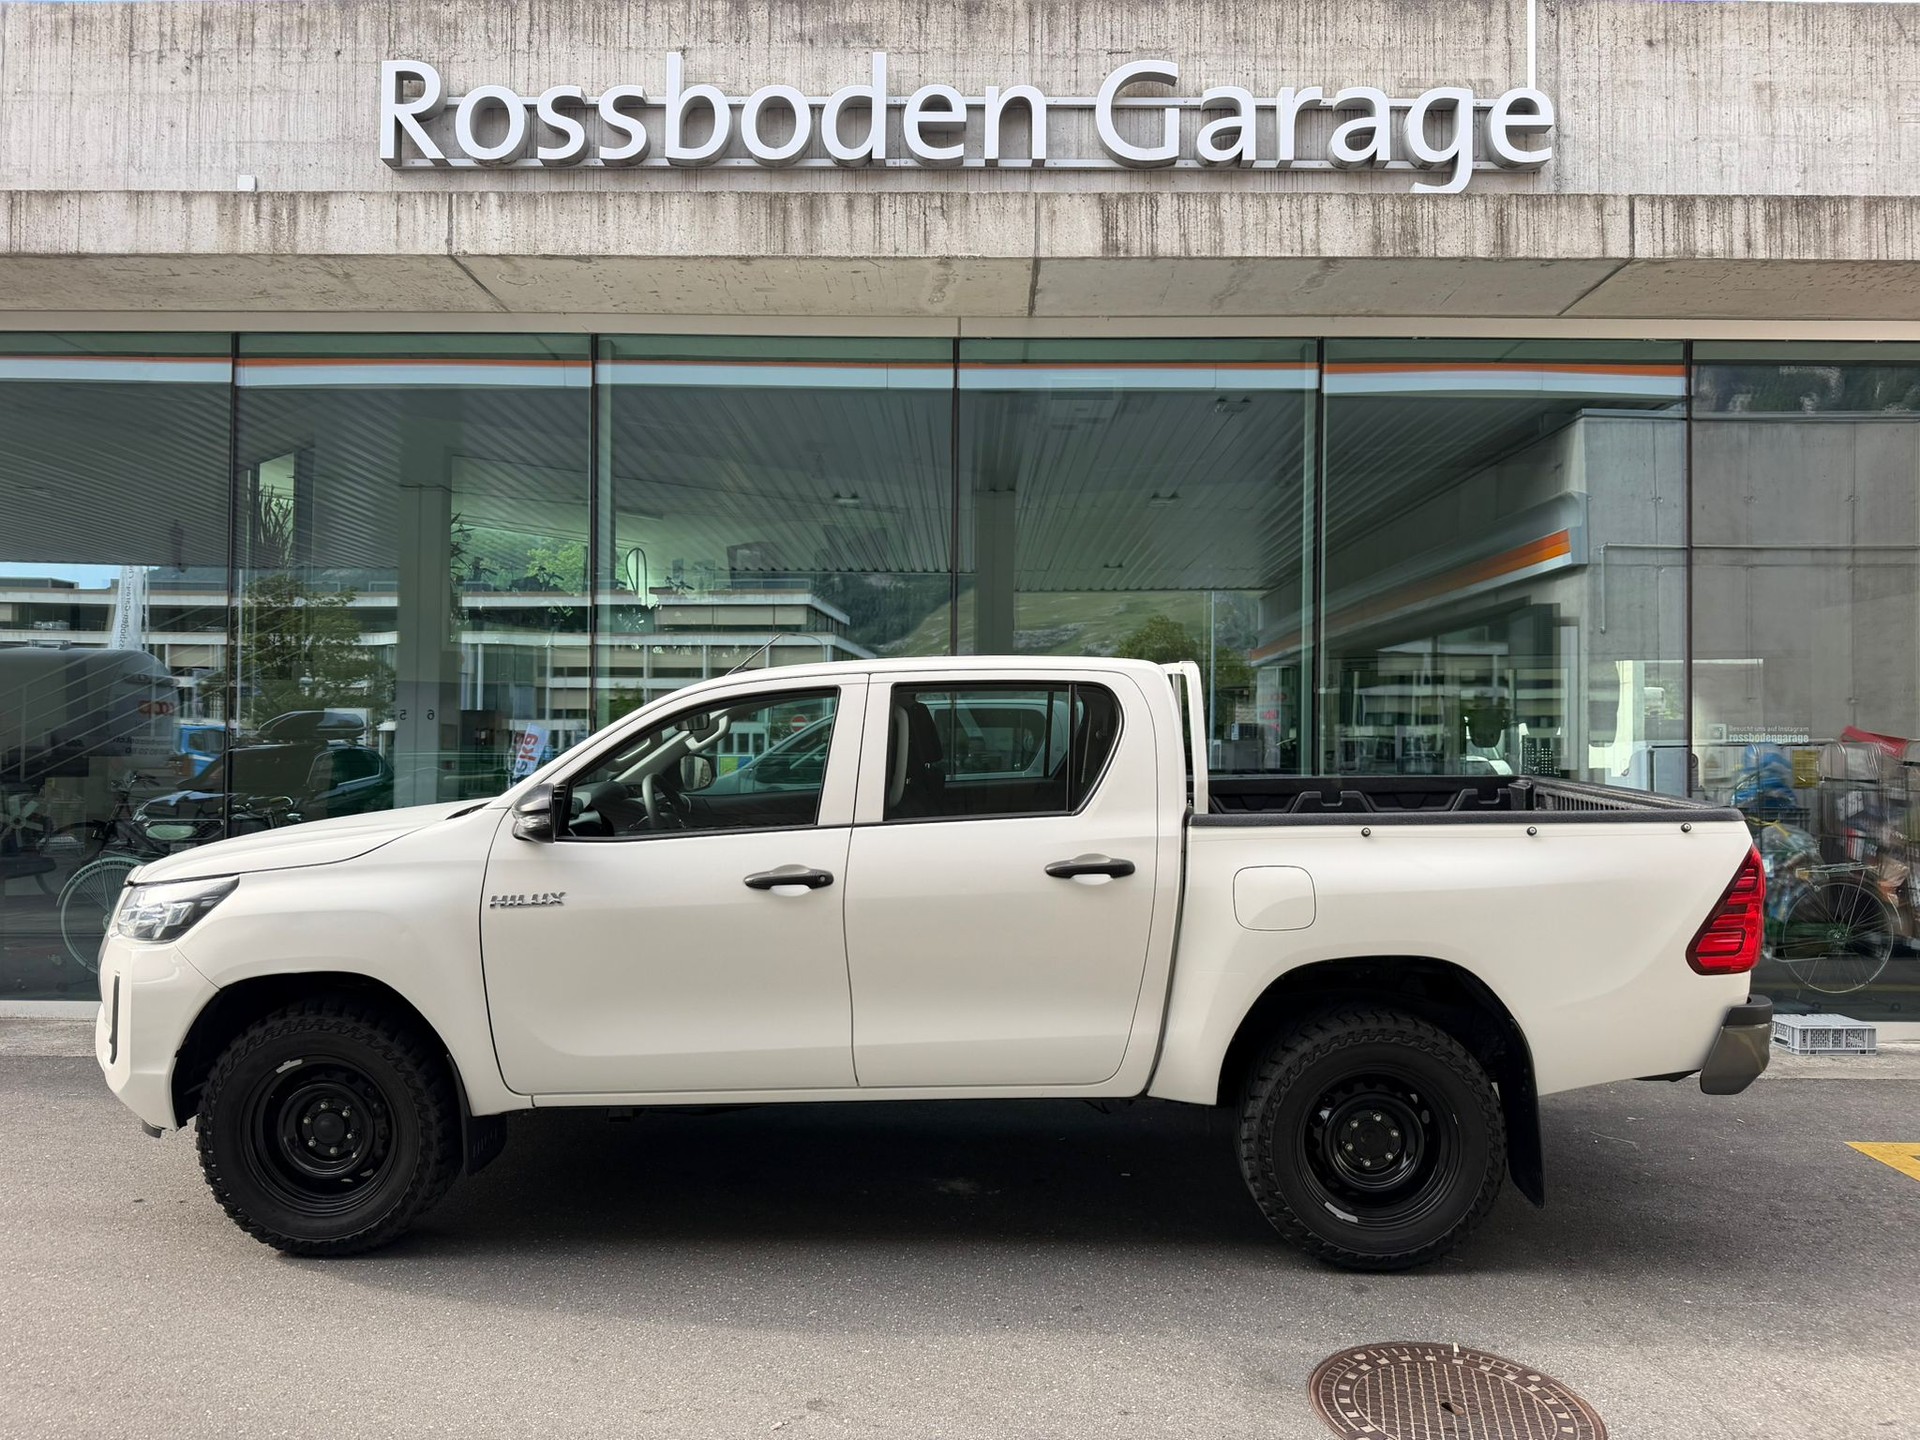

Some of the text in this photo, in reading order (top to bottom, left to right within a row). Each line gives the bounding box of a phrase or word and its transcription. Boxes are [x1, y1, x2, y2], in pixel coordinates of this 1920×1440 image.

[379, 51, 1555, 194] Rossboden Garage
[1728, 733, 1810, 744] rossbodengarage
[489, 891, 567, 909] HILUX
